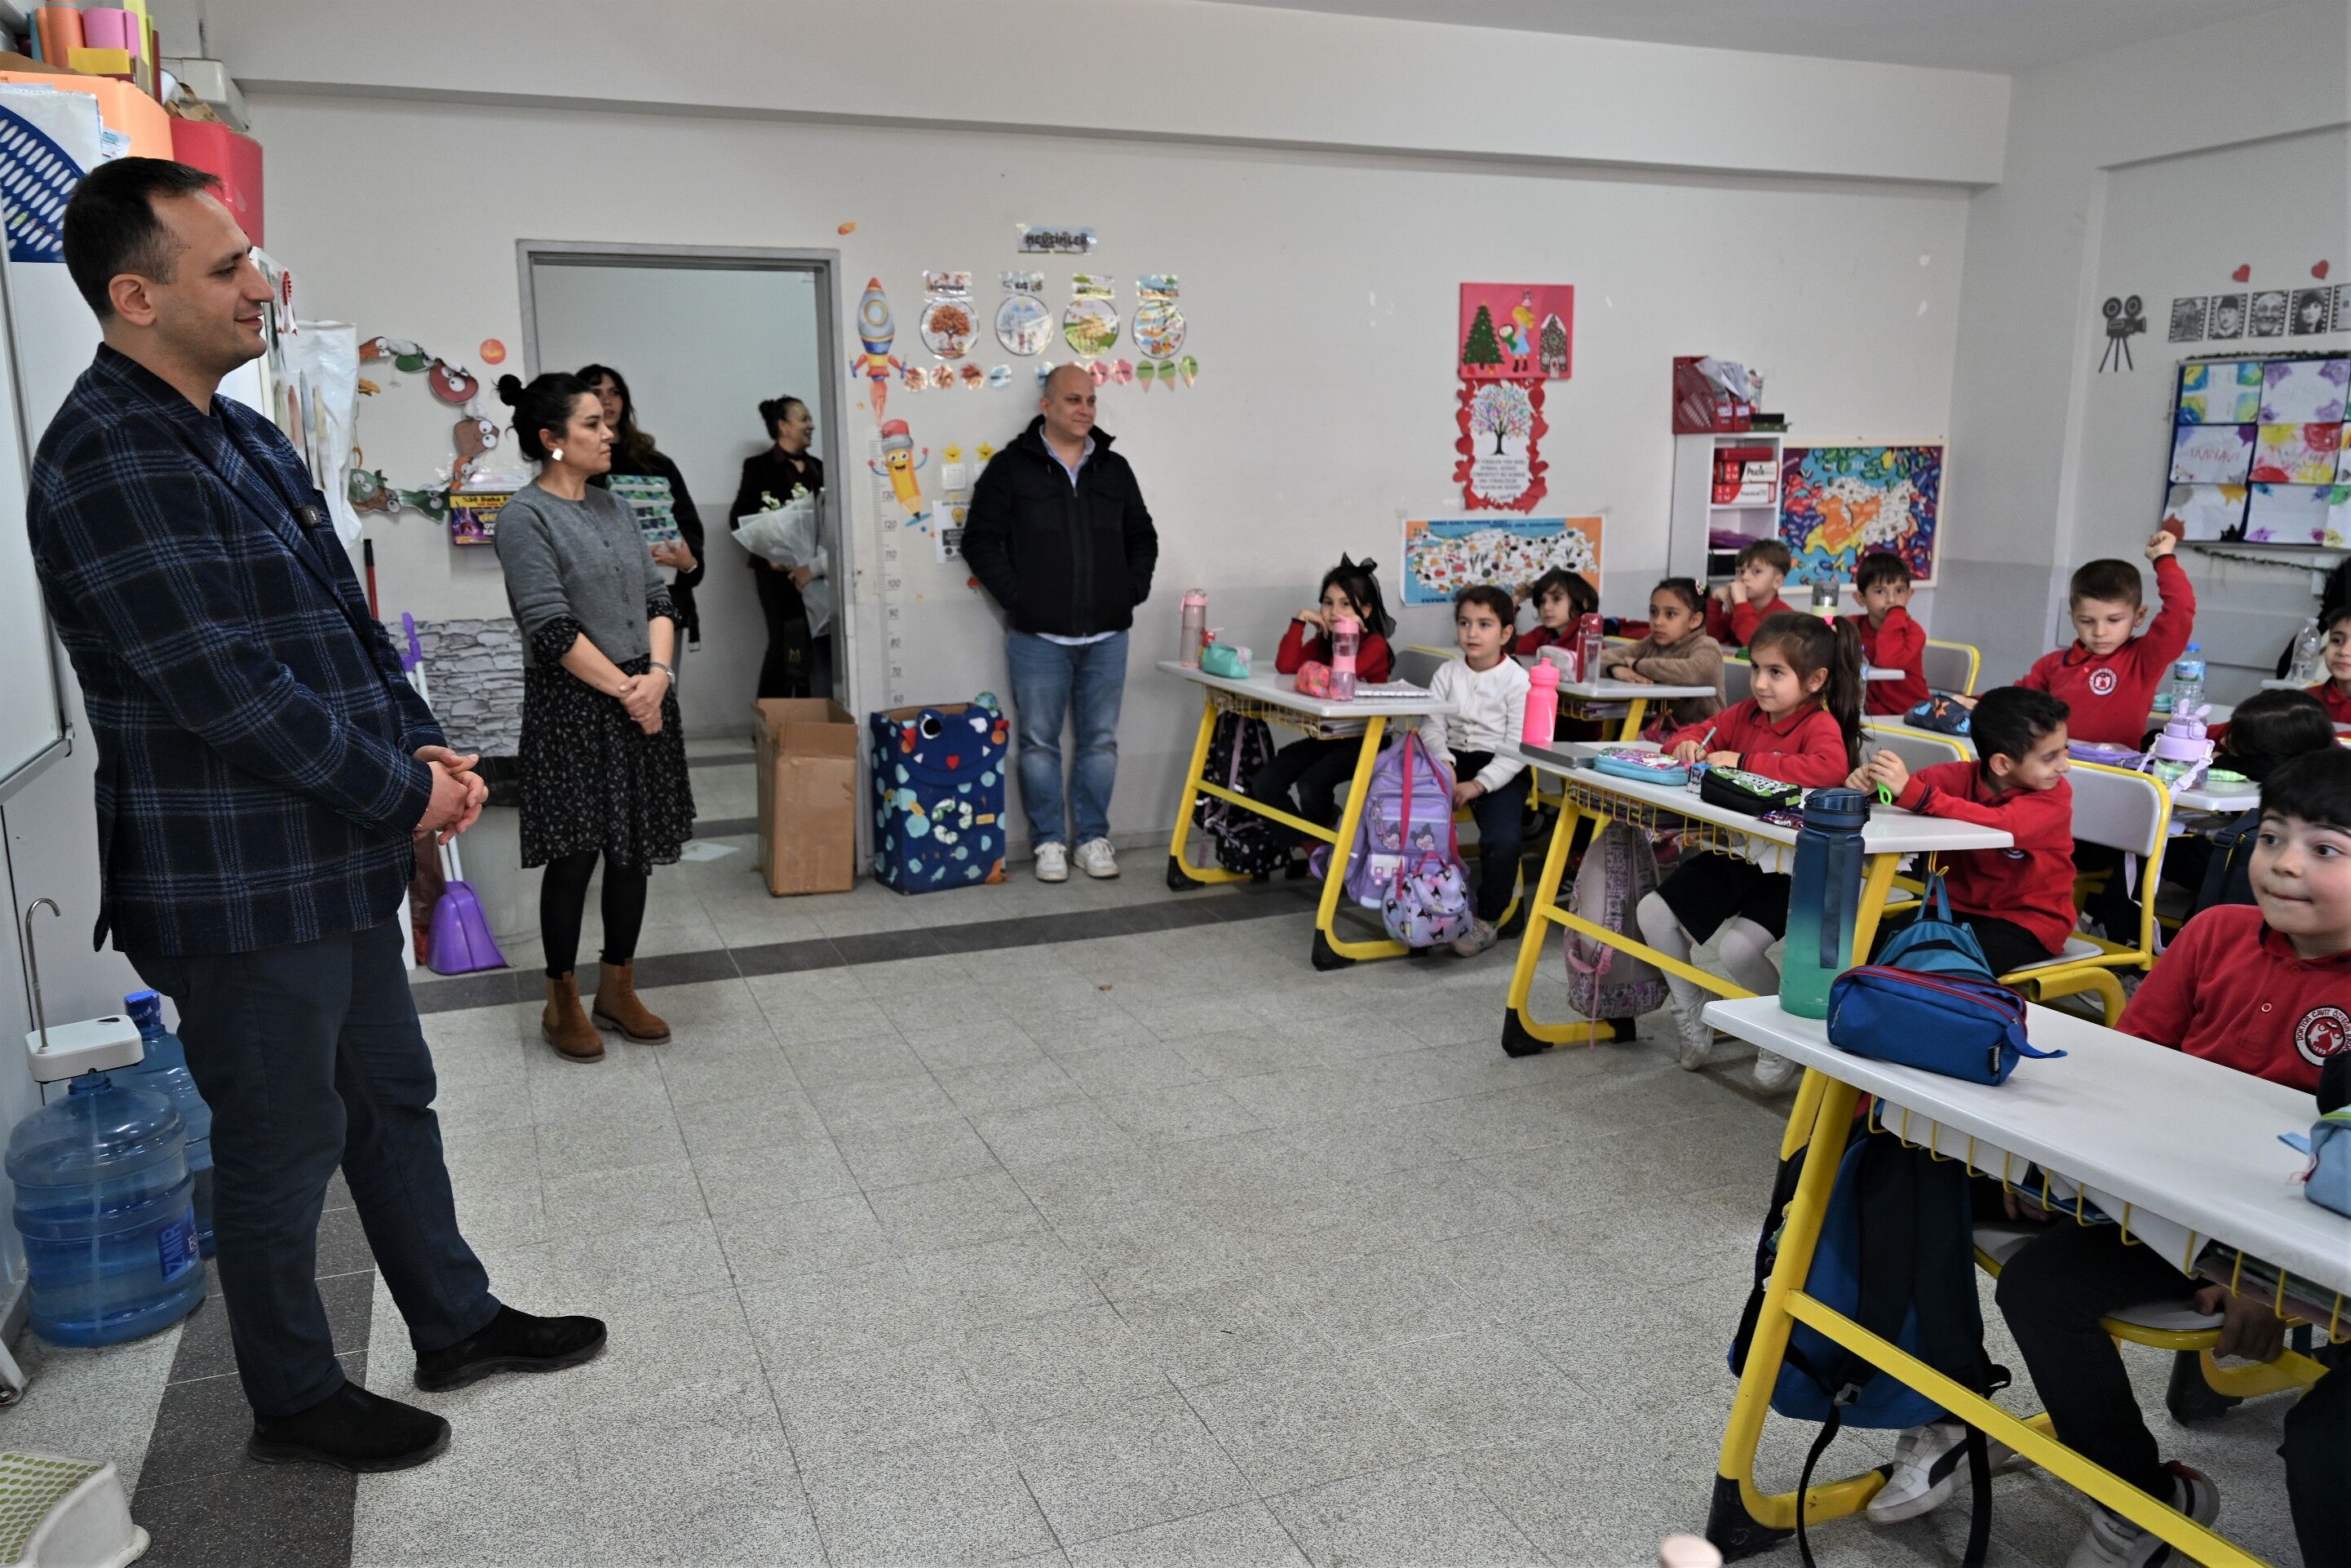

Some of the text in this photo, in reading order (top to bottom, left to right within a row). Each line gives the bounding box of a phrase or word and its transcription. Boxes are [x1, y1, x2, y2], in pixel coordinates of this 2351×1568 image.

[884, 520, 897, 529] 120
[886, 550, 897, 560] 110
[888, 579, 901, 587] 100
[2296, 1016, 2313, 1041] DOKTOR
